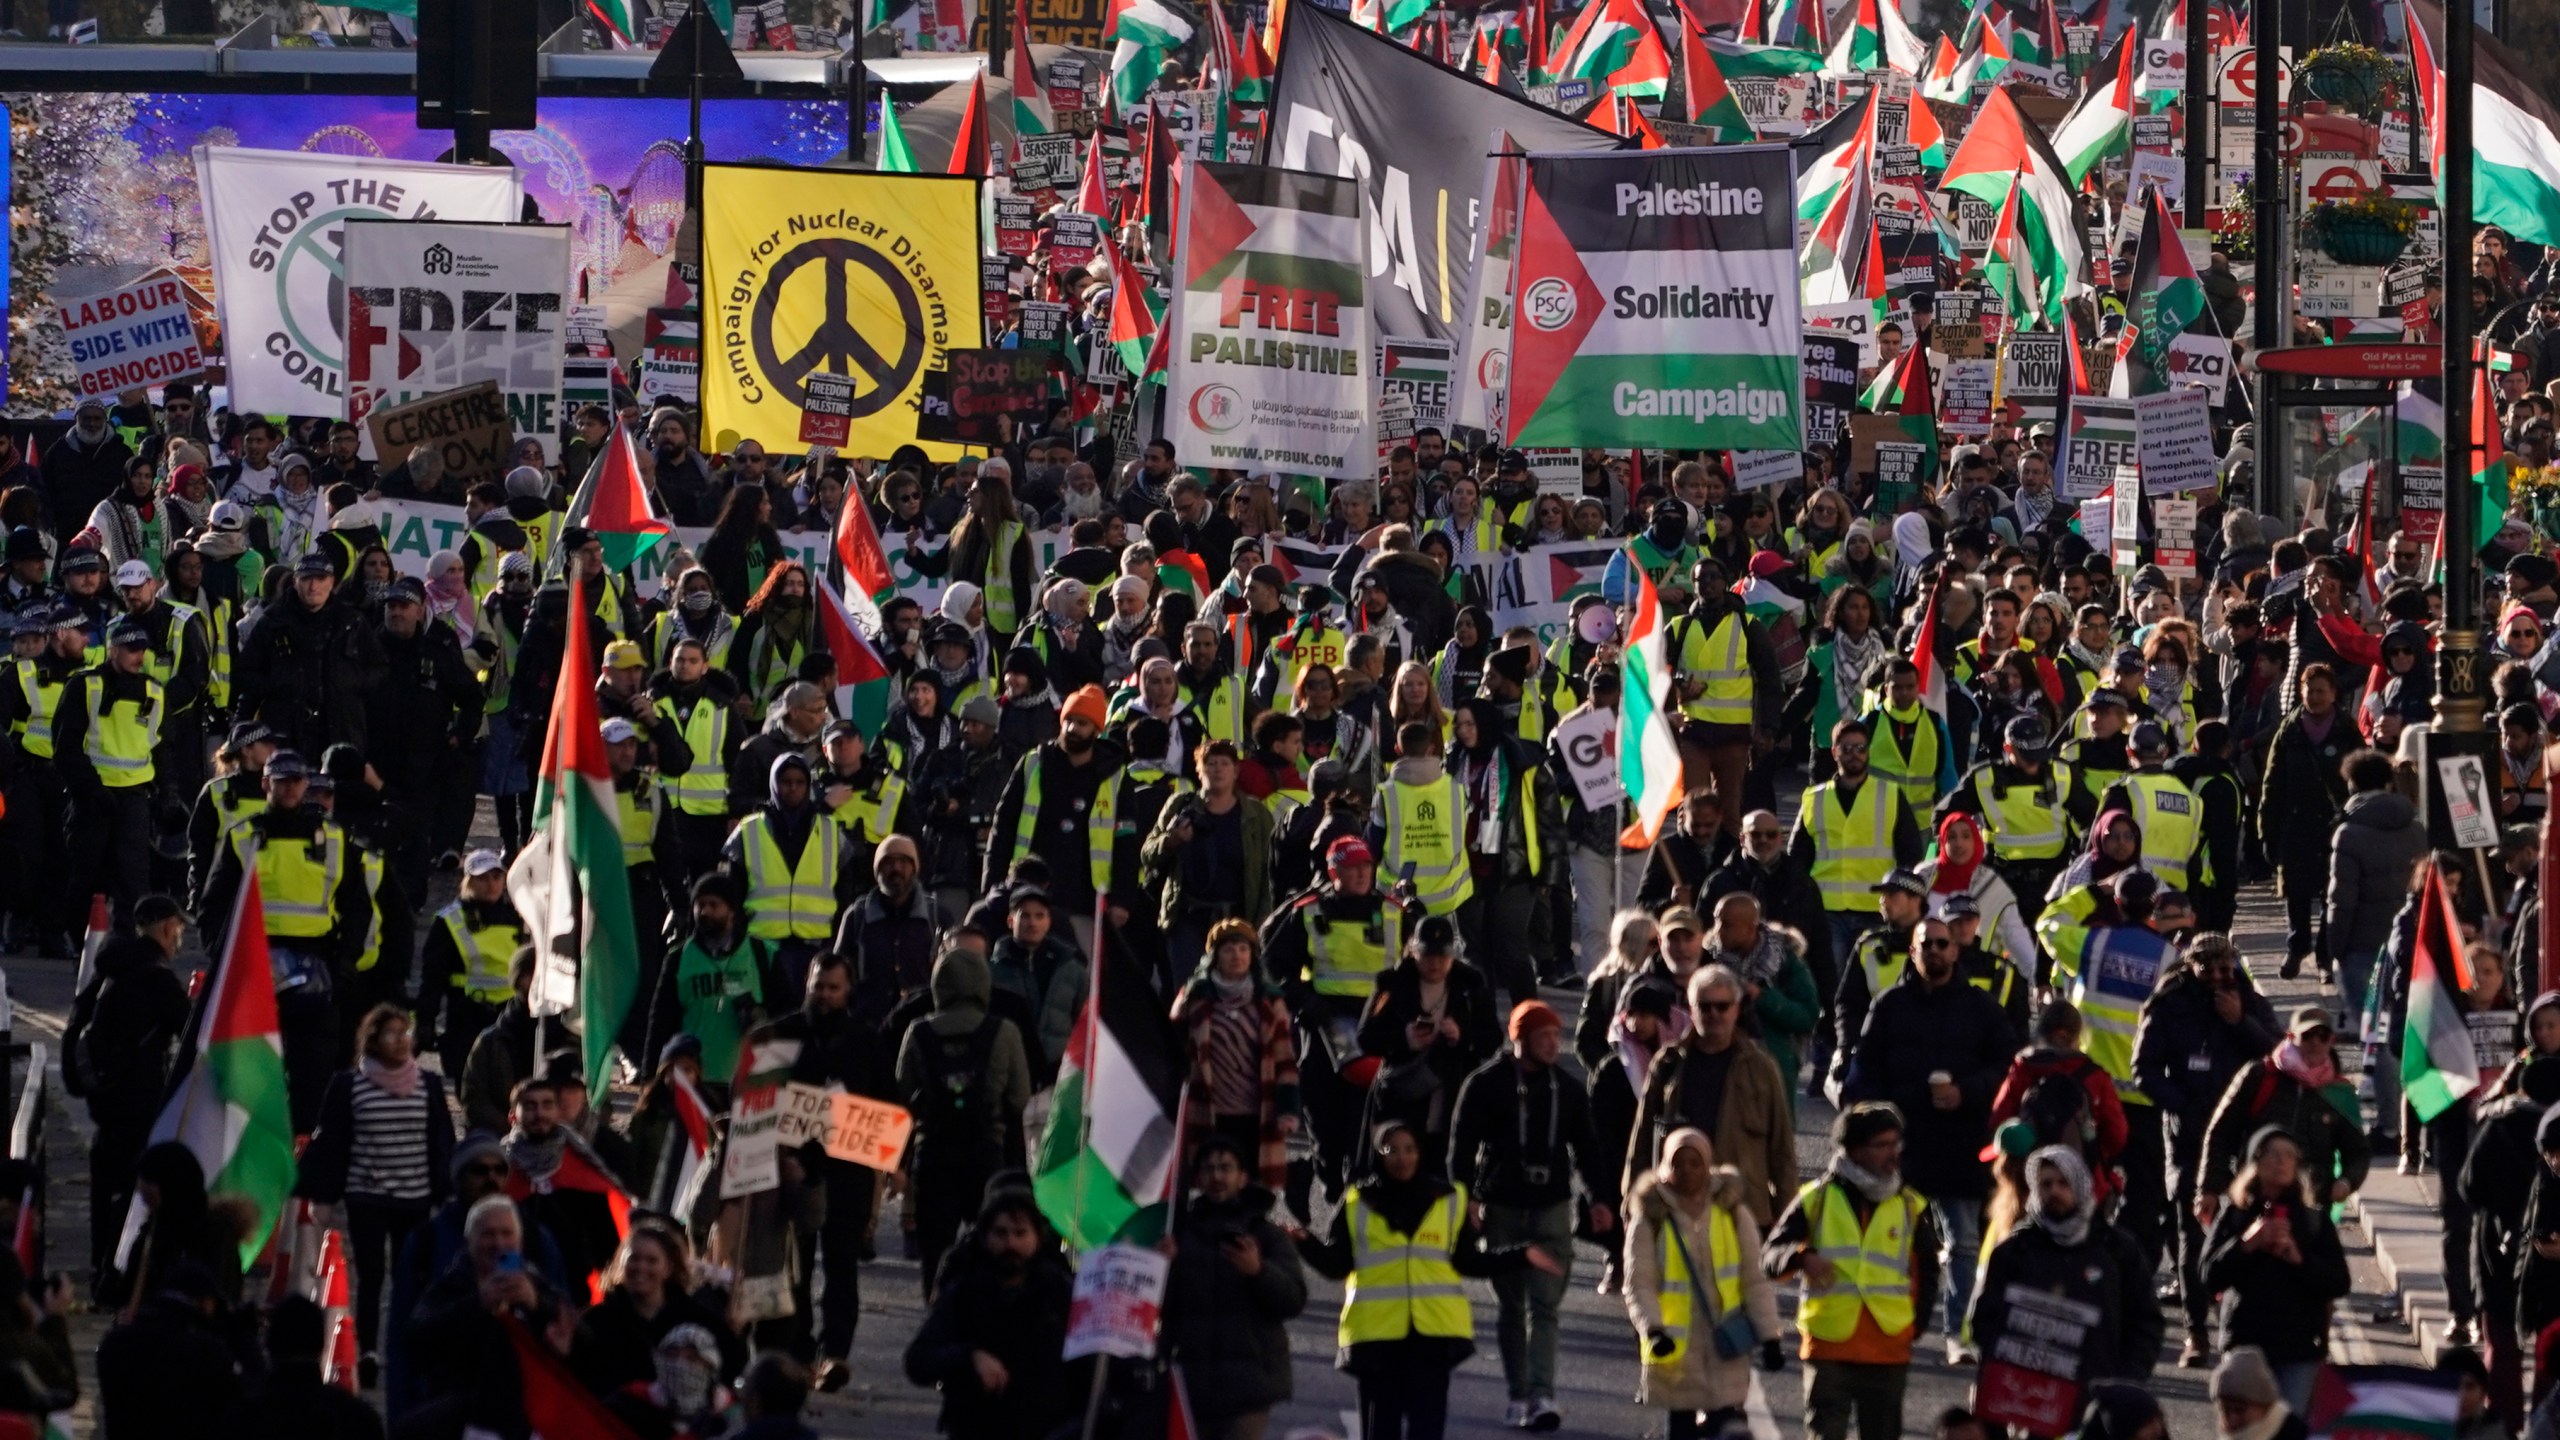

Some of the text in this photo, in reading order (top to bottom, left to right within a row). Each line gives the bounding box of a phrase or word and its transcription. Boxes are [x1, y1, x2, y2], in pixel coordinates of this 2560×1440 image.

[1024, 139, 1073, 158] CEASEFIRE
[1615, 182, 1763, 218] Palestine
[1001, 204, 1031, 215] REEDOM
[249, 178, 406, 273] STOP THE
[1057, 221, 1093, 233] FREEDOM
[1878, 216, 1911, 230] FREEDOM
[1053, 235, 1093, 247] PALESTINE
[456, 254, 483, 263] Muslim
[456, 262, 499, 271] Association
[466, 270, 491, 278] Britain
[2334, 280, 2345, 289] 19
[2392, 274, 2424, 291] FREEDOM
[60, 281, 181, 331] LABOUR
[723, 268, 764, 405] Campaign
[751, 229, 781, 266] for
[787, 208, 888, 241] Nuclear
[1219, 279, 1340, 338] FREE
[1535, 297, 1566, 313] PSC
[1613, 285, 1774, 327] Solidarity
[1940, 300, 1974, 309] FROM THE
[2303, 302, 2323, 310] N19
[1024, 310, 1061, 322] FROM THE
[1940, 309, 1971, 318] RIVER TO
[1023, 320, 1057, 331] RIVER TO
[1935, 324, 1981, 340] SCOTLAND
[70, 313, 191, 363] SIDE WITH
[348, 286, 562, 388] FREE
[1023, 329, 1053, 340] THE SEA
[1942, 339, 1969, 348] STANDS
[1190, 332, 1358, 376] PALESTINE
[2011, 343, 2059, 361] CEASEFI
[2362, 352, 2428, 362] Old Park Lane
[80, 346, 203, 397] GENOCIDE
[955, 352, 1010, 386] Stop
[1804, 362, 1855, 385] estine
[2018, 362, 2059, 387] NOW
[809, 382, 851, 398] FREEDOM
[1383, 380, 1448, 406] FREE
[1950, 391, 1987, 399] END ISRAELI
[805, 398, 851, 415] PALESTINE
[1613, 381, 1787, 425] Campaign
[1946, 399, 1989, 408] STATE TERROR
[2138, 398, 2179, 410] Ceasefire
[383, 391, 506, 447] CEASEFIRE
[2141, 407, 2202, 422] End Israel's
[1251, 414, 1296, 428] Palestinian
[1298, 418, 1321, 430] Forum
[1330, 423, 1360, 434] Britain
[2143, 419, 2204, 435] occupation!
[2142, 434, 2209, 451] End Hamas's
[1211, 445, 1344, 468] WWW.PFBUK.COM
[1881, 451, 1919, 462] FROM THE
[2068, 440, 2135, 466] FREE
[1737, 461, 1753, 472] Stop
[1753, 457, 1765, 467] the
[1880, 462, 1914, 472] RIVER TO
[2145, 458, 2211, 473] homophobic,
[1880, 472, 1910, 482] THE SEA
[2147, 468, 2212, 486] dictatorship!
[1584, 776, 1610, 792] Stop
[2157, 791, 2190, 814] POLICE
[1405, 824, 1433, 832] Muslim
[1405, 833, 1450, 841] Association
[1414, 841, 1442, 849] Britain
[791, 1090, 886, 1129] TOP THE
[777, 1112, 881, 1156] ENOCIDE
[2007, 1306, 2087, 1348] FREEDOM
[1994, 1336, 2080, 1382] PALESTINE
